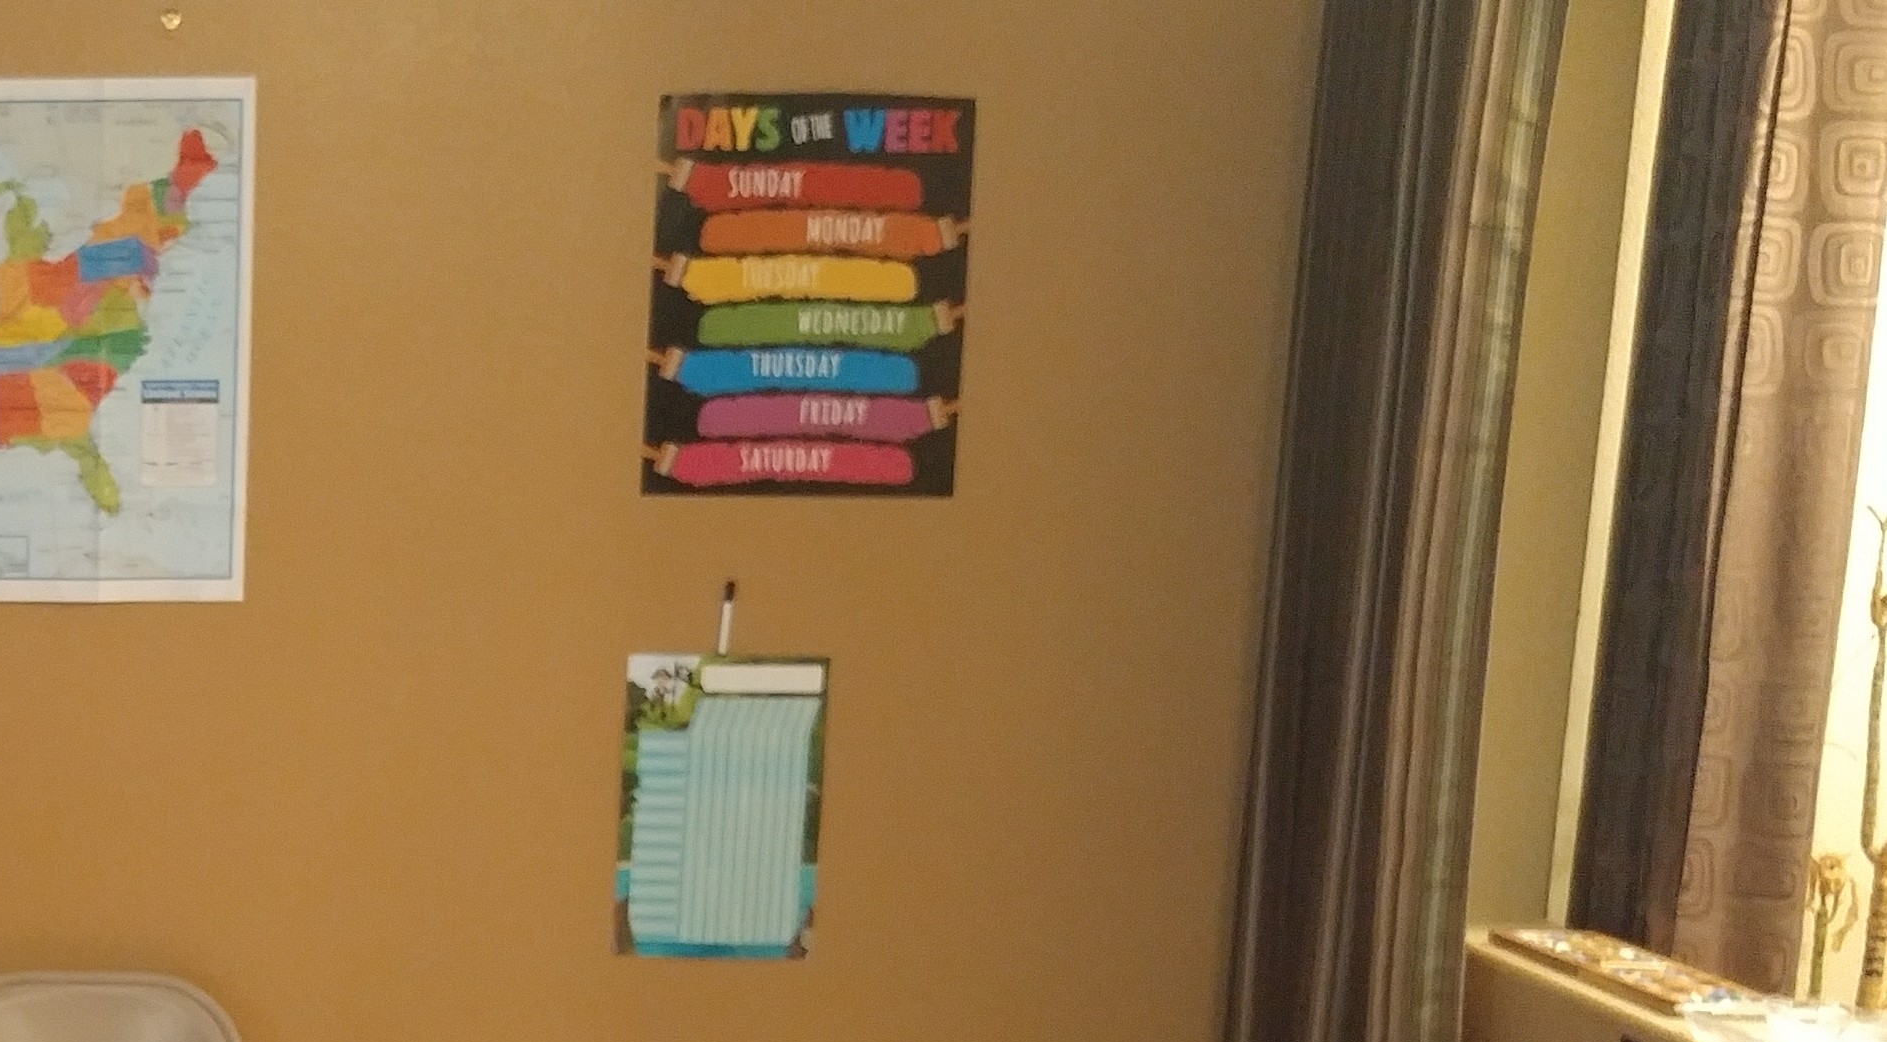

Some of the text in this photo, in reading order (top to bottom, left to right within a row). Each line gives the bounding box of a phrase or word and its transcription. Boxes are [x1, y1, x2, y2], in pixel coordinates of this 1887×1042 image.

[676, 106, 781, 152] DAYS
[790, 115, 810, 145] OF
[843, 108, 960, 154] WEEK
[728, 169, 805, 198] SUNDAY
[807, 215, 886, 244] MONDAY
[742, 258, 820, 290] TUESDAY
[798, 308, 906, 336] WEDNESDAY
[751, 352, 843, 378] THURSDAY
[799, 396, 868, 426] FRIDAY
[740, 445, 832, 473] SATURDAY
